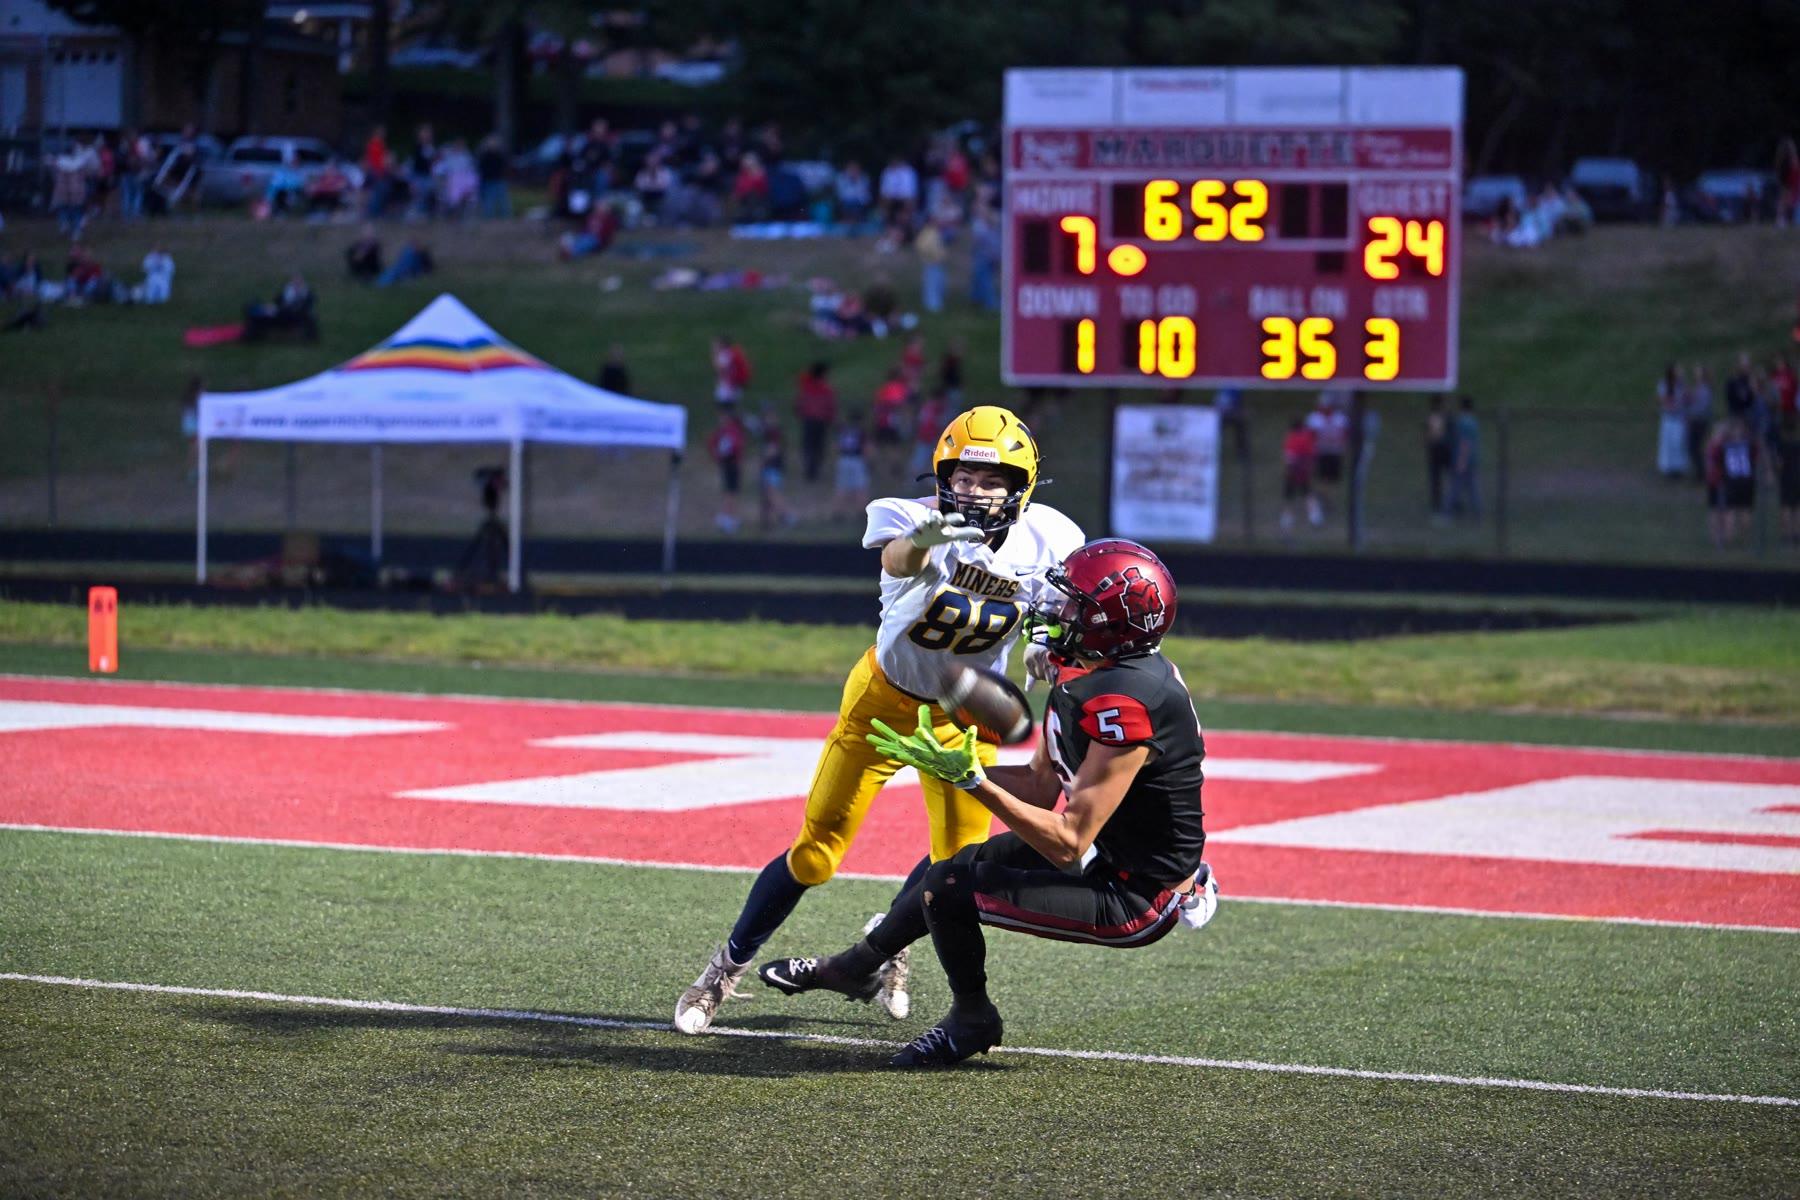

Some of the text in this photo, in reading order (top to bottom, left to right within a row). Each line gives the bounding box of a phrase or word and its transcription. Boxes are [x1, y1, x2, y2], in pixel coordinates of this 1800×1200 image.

[1094, 135, 1354, 166] MARQUETTE
[1015, 185, 1096, 211] HOME
[1359, 187, 1447, 214] GUEST
[1060, 216, 1096, 275] 7
[1364, 216, 1445, 280] 24
[1018, 286, 1098, 317] DOWN
[1119, 286, 1198, 317] TO GO
[1249, 286, 1347, 317] BALL ON
[1373, 286, 1428, 317] QTR
[1077, 319, 1096, 374] 1
[1138, 316, 1197, 378] 10
[1261, 317, 1337, 380] 35
[1364, 317, 1400, 380] 3
[964, 448, 997, 460] Riddell
[951, 562, 1020, 598] MINERS
[908, 589, 1024, 655] 88
[1097, 708, 1125, 742] 5
